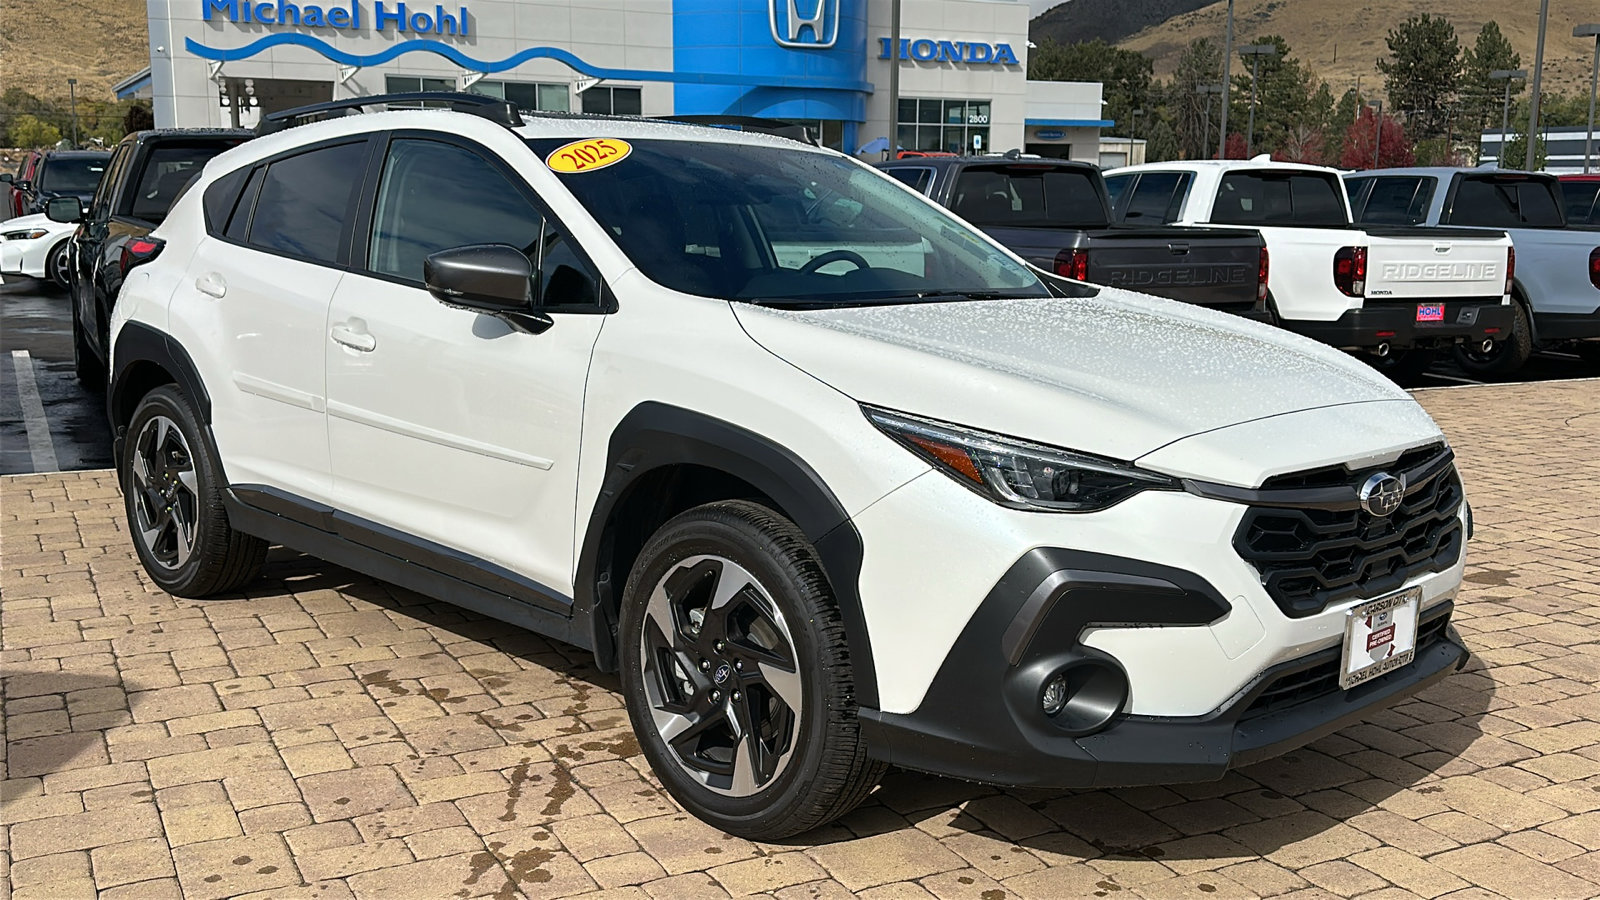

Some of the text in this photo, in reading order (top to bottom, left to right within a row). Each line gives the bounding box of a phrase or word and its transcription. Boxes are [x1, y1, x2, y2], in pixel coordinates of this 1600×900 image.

[202, 0, 468, 36] Michael Hohl
[880, 37, 1019, 65] HONDA
[968, 114, 988, 124] 2800
[561, 140, 618, 169] 2025
[1109, 267, 1247, 286] RIDGELINE
[1382, 263, 1497, 280] RIDGELINE
[1418, 307, 1441, 316] HOHL
[1367, 599, 1393, 614] CARSON
[1372, 628, 1391, 640] CERTIFIED
